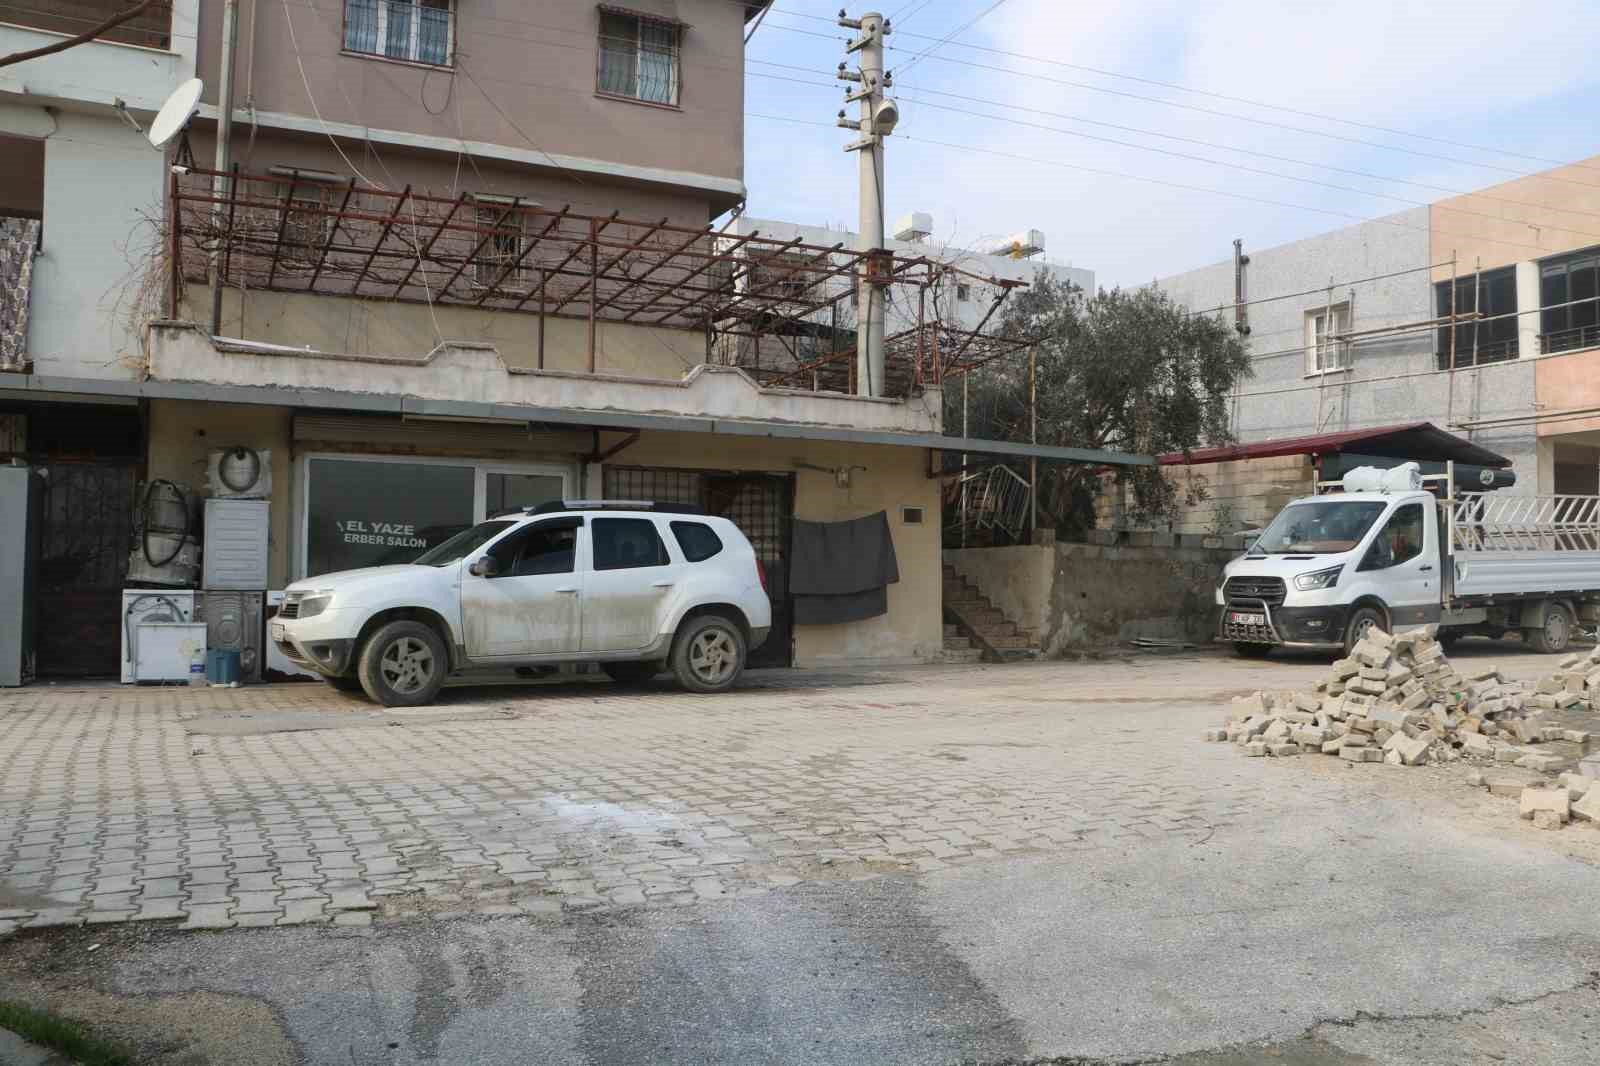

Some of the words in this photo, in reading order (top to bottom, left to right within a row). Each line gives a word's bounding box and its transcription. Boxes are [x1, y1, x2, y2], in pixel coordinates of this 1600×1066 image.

[371, 522, 415, 536] YAZE
[343, 533, 385, 545] ERBER
[386, 536, 427, 548] SALON
